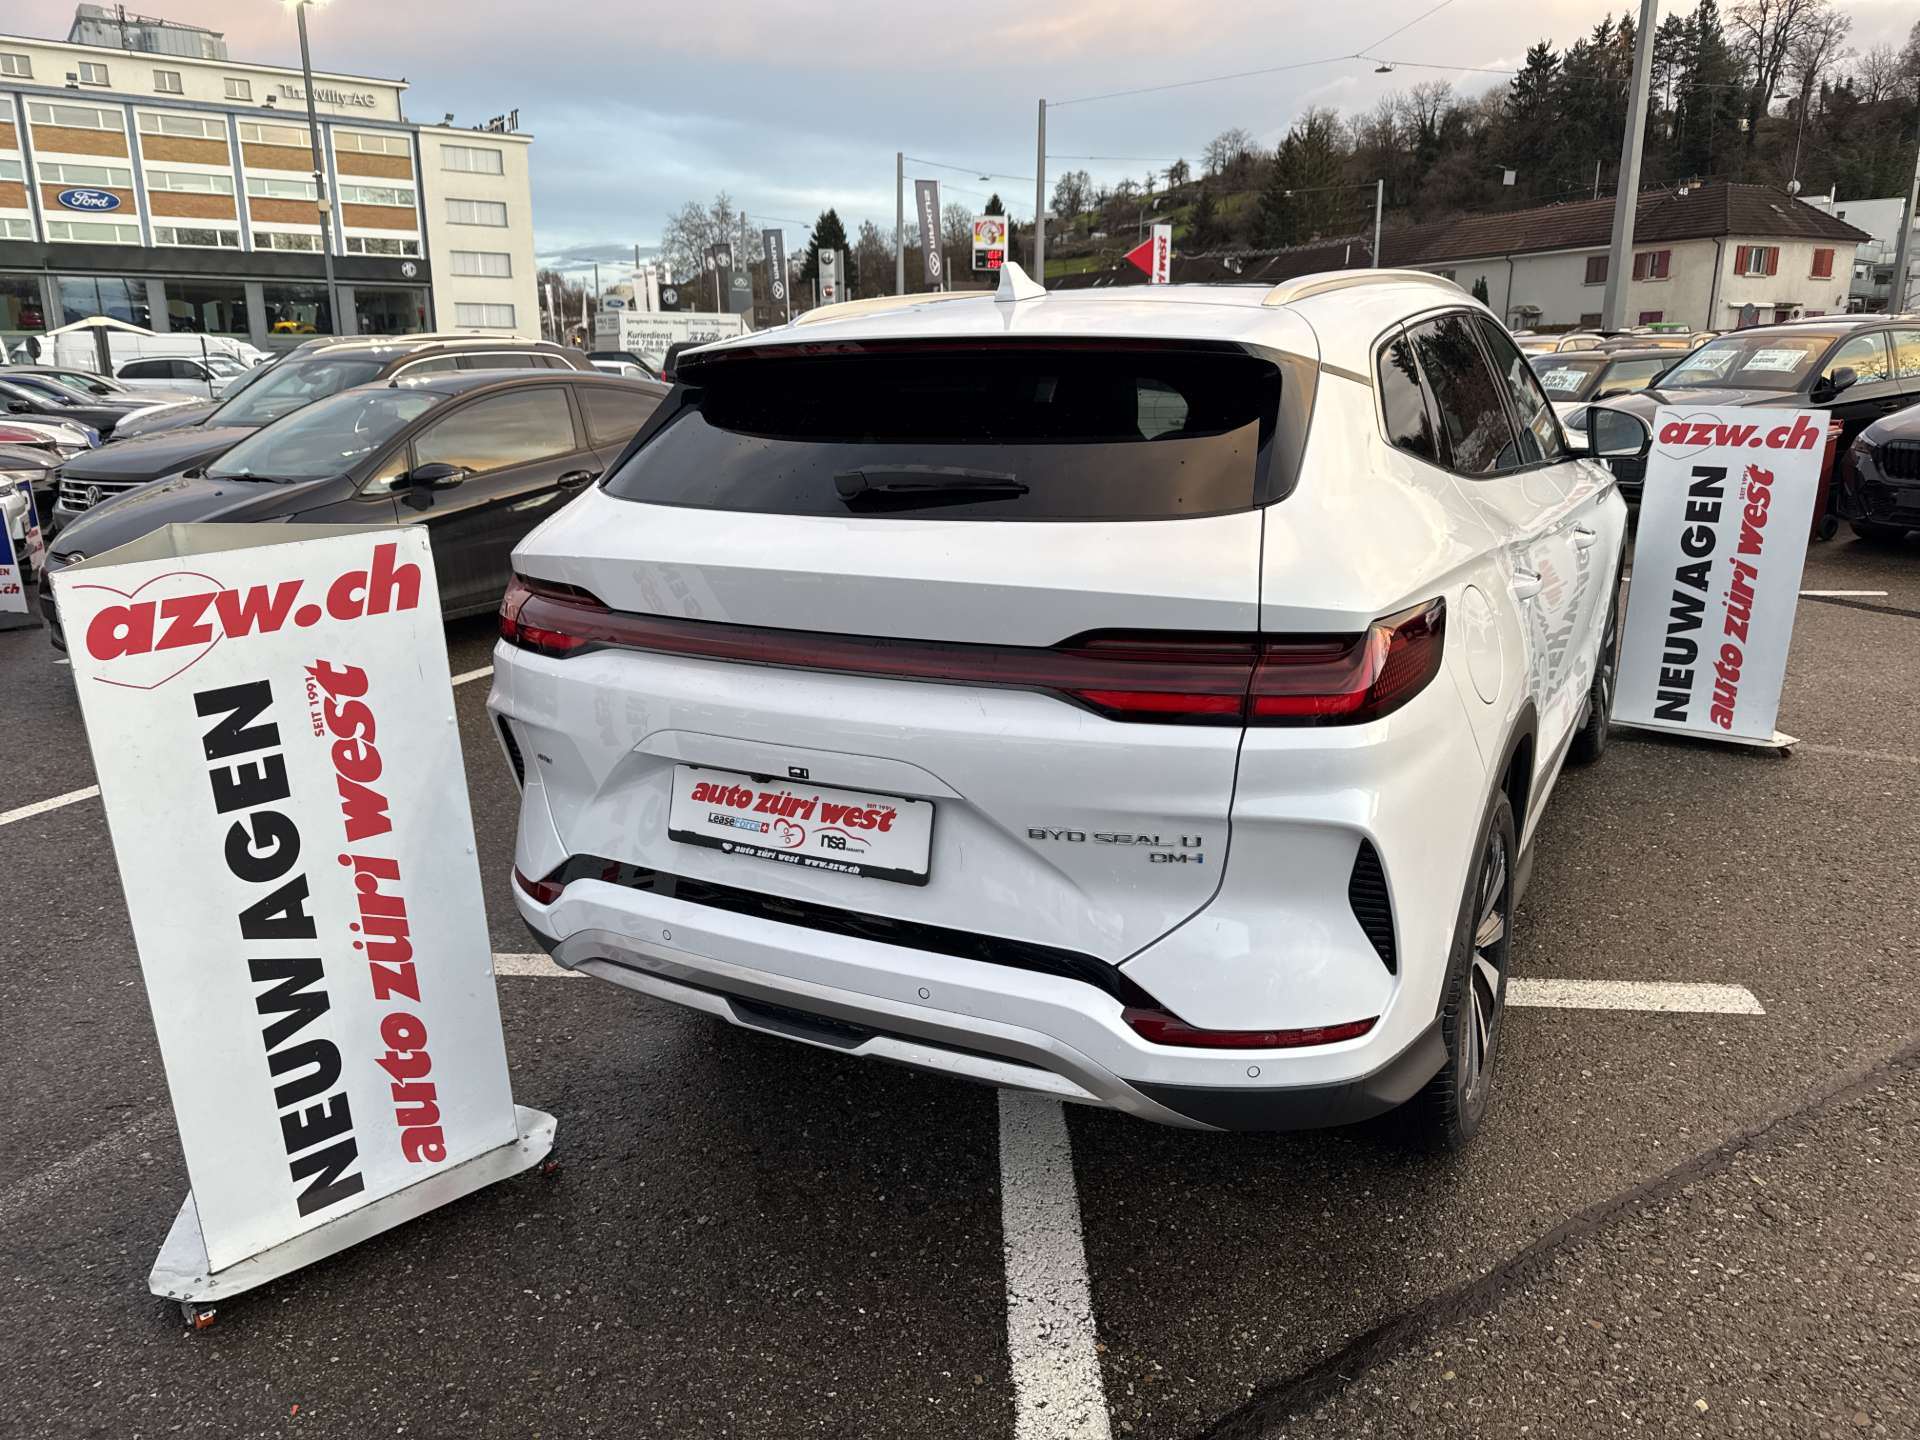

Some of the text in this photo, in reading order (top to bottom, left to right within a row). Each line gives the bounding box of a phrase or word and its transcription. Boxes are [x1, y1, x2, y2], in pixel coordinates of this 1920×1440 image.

[352, 91, 377, 108] AG
[71, 190, 109, 207] Ford
[627, 331, 672, 340] Kurierdienst
[1659, 416, 1819, 450] azw.ch
[86, 543, 421, 660] azw.ch
[1653, 465, 1728, 722] NEUWAGEN
[1710, 463, 1775, 730] auto züri west
[306, 676, 325, 738] SEIT 1991
[691, 782, 897, 832] auto züri west
[734, 844, 860, 874] auto züri west www.azw.ch
[820, 832, 846, 850] nsa
[1028, 828, 1202, 848] BYD SEAL U
[304, 659, 446, 1163] auto züri west
[194, 679, 365, 1218] NEUWAGEN
